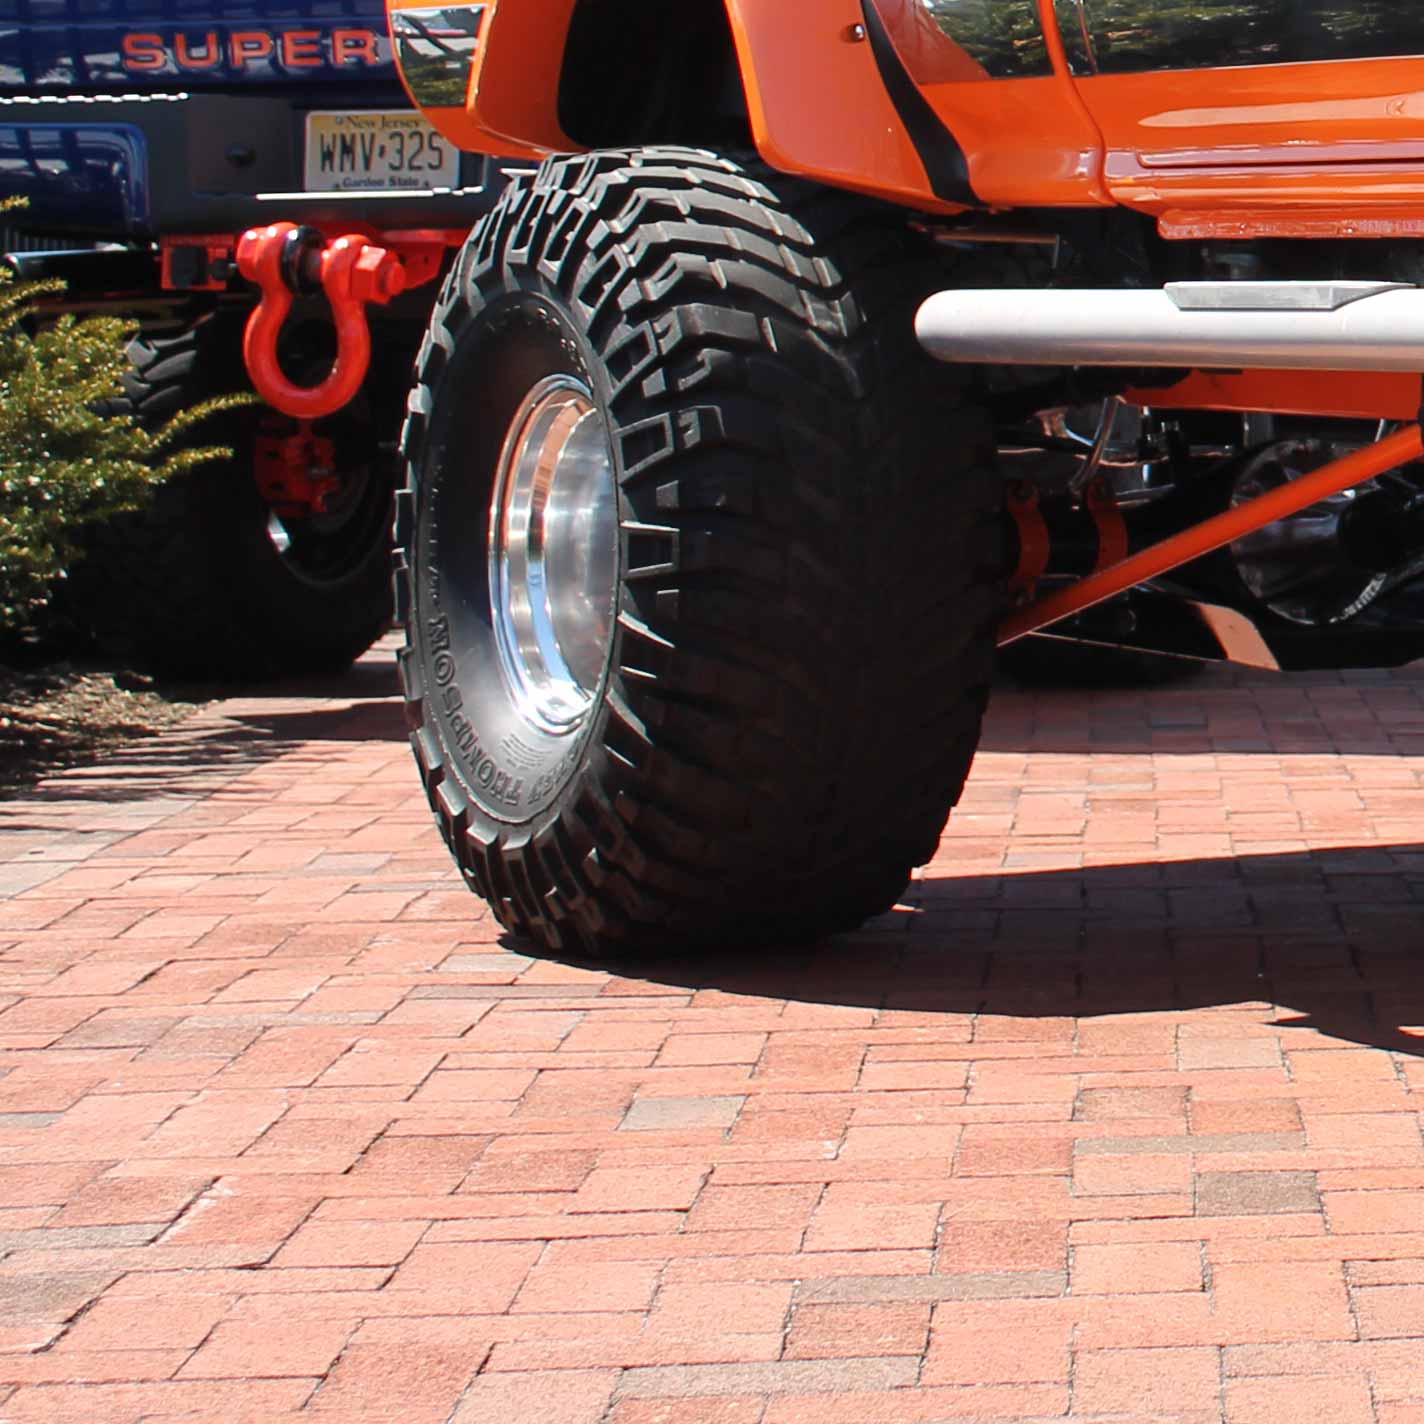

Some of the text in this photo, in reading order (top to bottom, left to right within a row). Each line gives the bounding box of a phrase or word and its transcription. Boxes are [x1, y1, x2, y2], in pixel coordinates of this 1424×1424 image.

[121, 28, 381, 71] SUPER
[346, 114, 420, 130] New Jersey
[428, 612, 525, 806] THOMPSON
